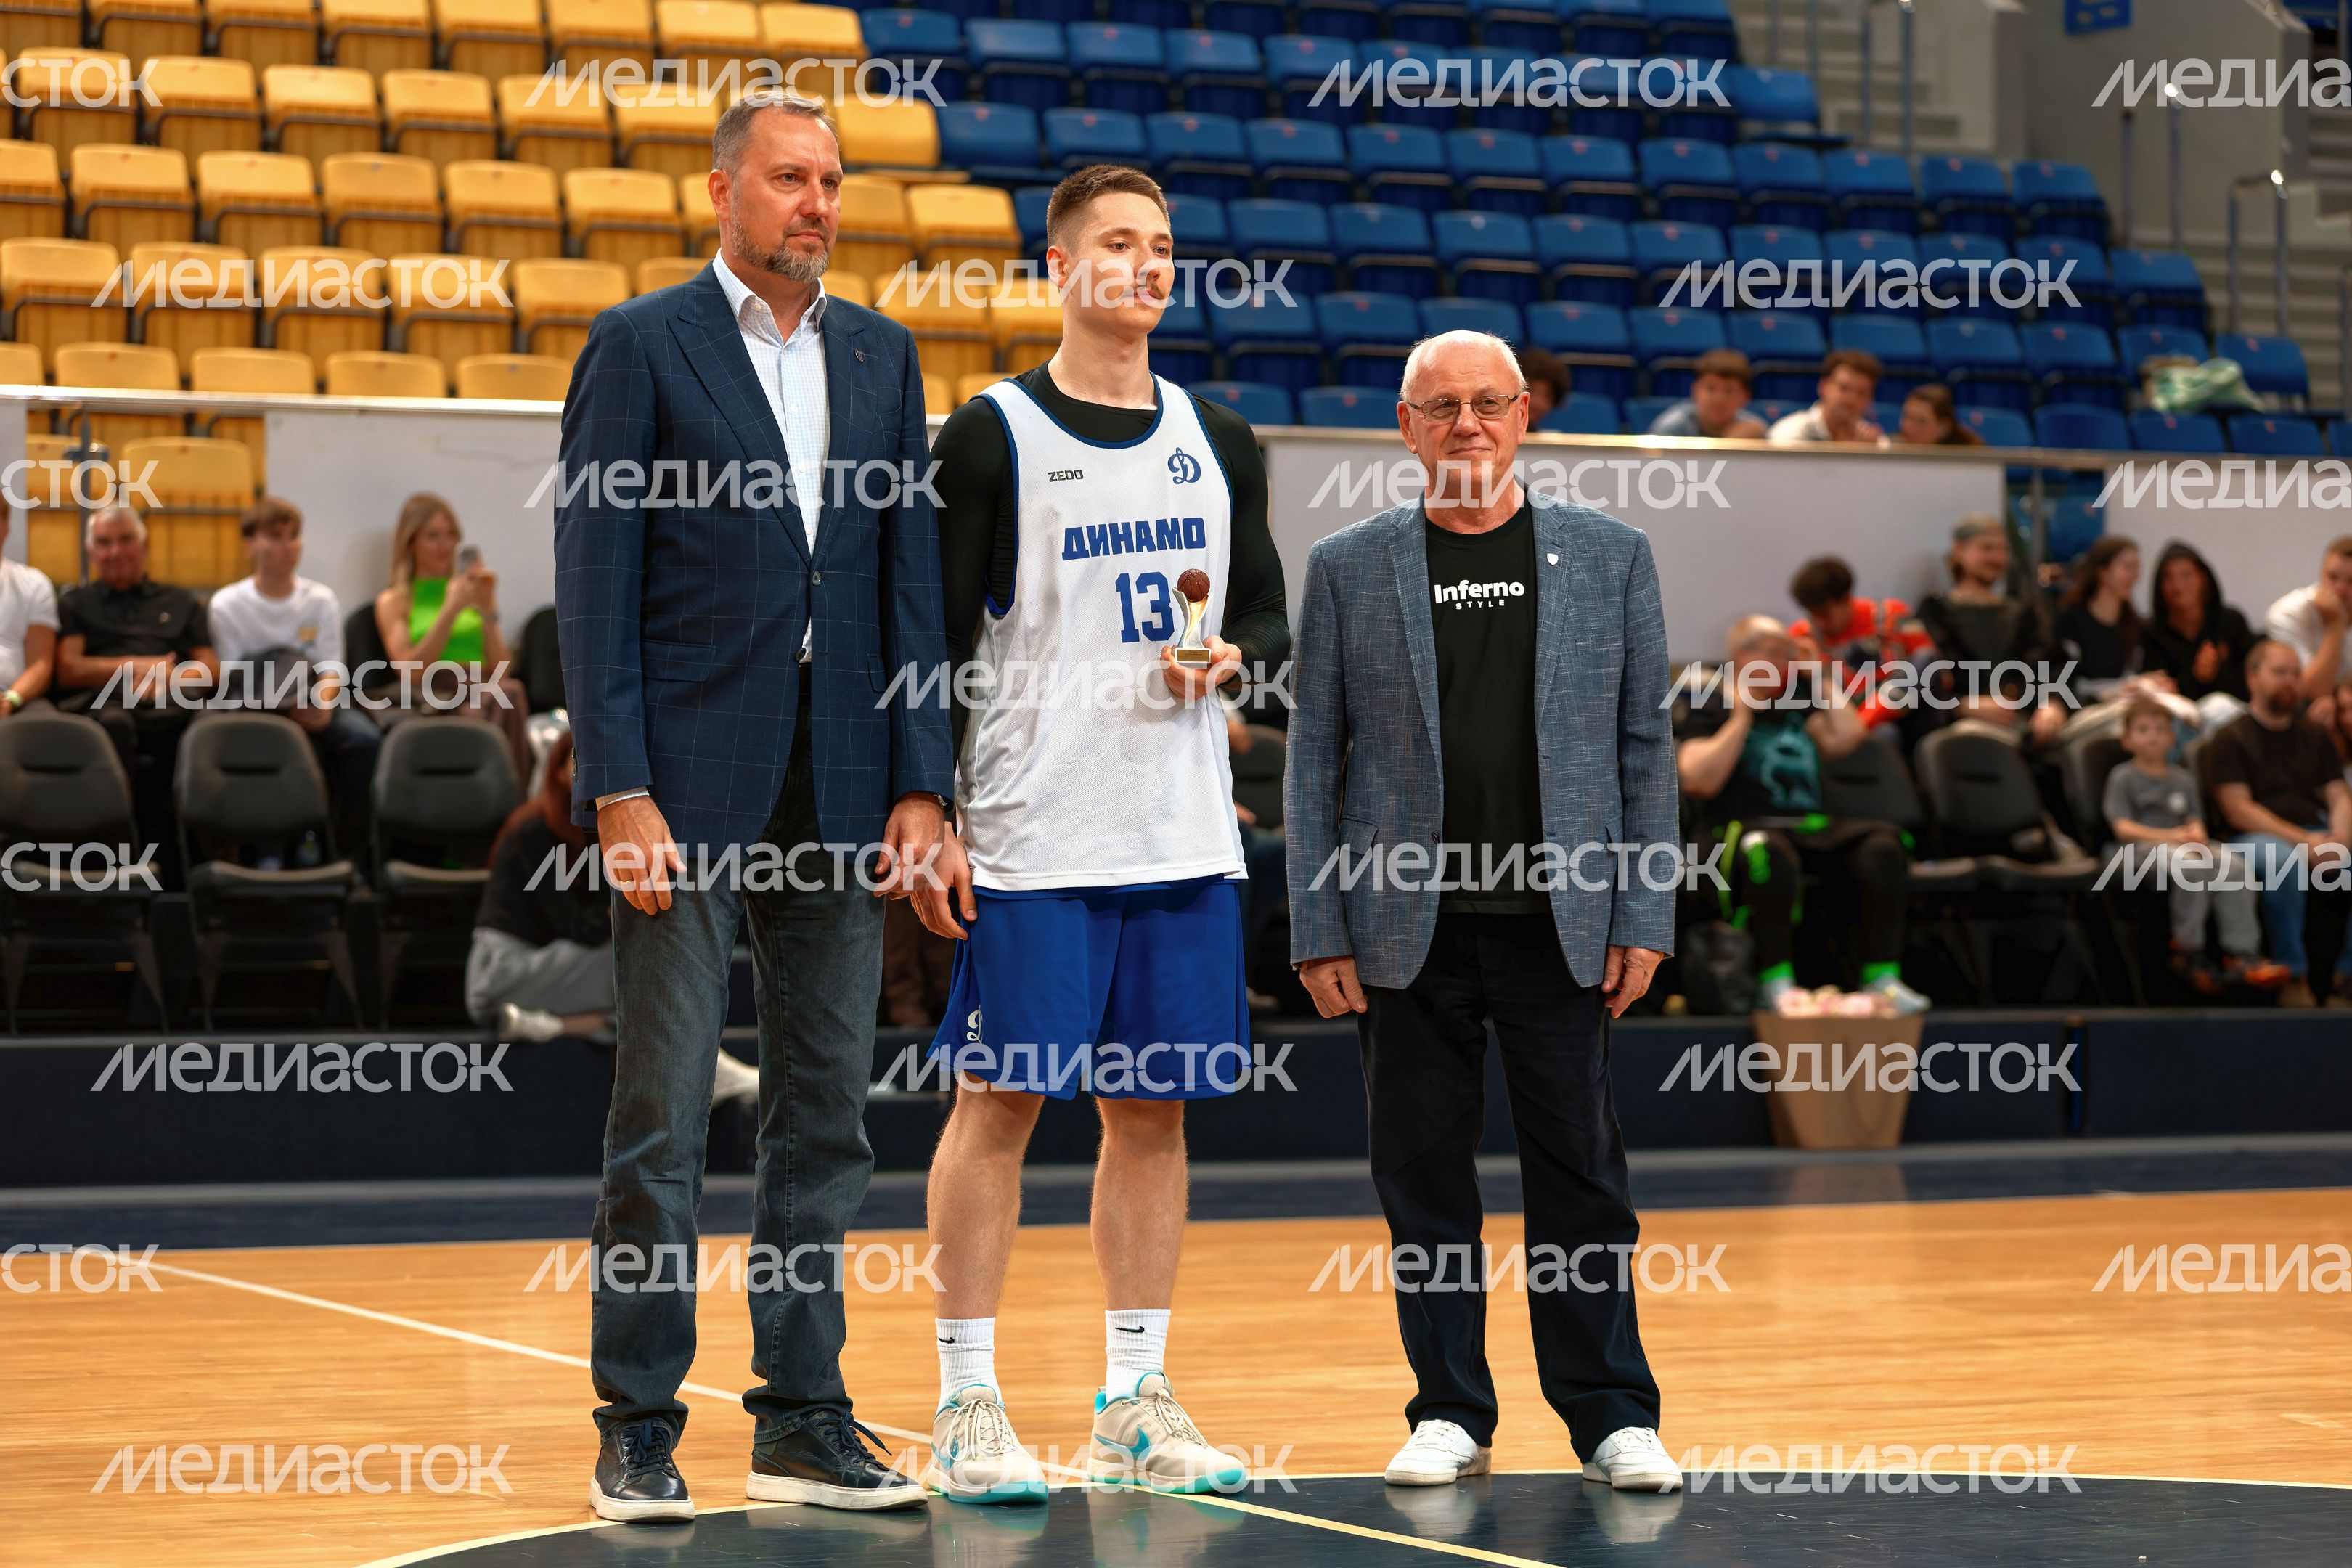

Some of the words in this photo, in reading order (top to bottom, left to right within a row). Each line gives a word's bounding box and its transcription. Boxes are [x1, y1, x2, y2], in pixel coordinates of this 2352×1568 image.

[1048, 469, 1084, 482] ZEDO
[1062, 518, 1206, 561] ДИНАМО
[1434, 579, 1524, 604] Inferno
[1115, 571, 1175, 643] 13
[1455, 599, 1505, 610] STYLE
